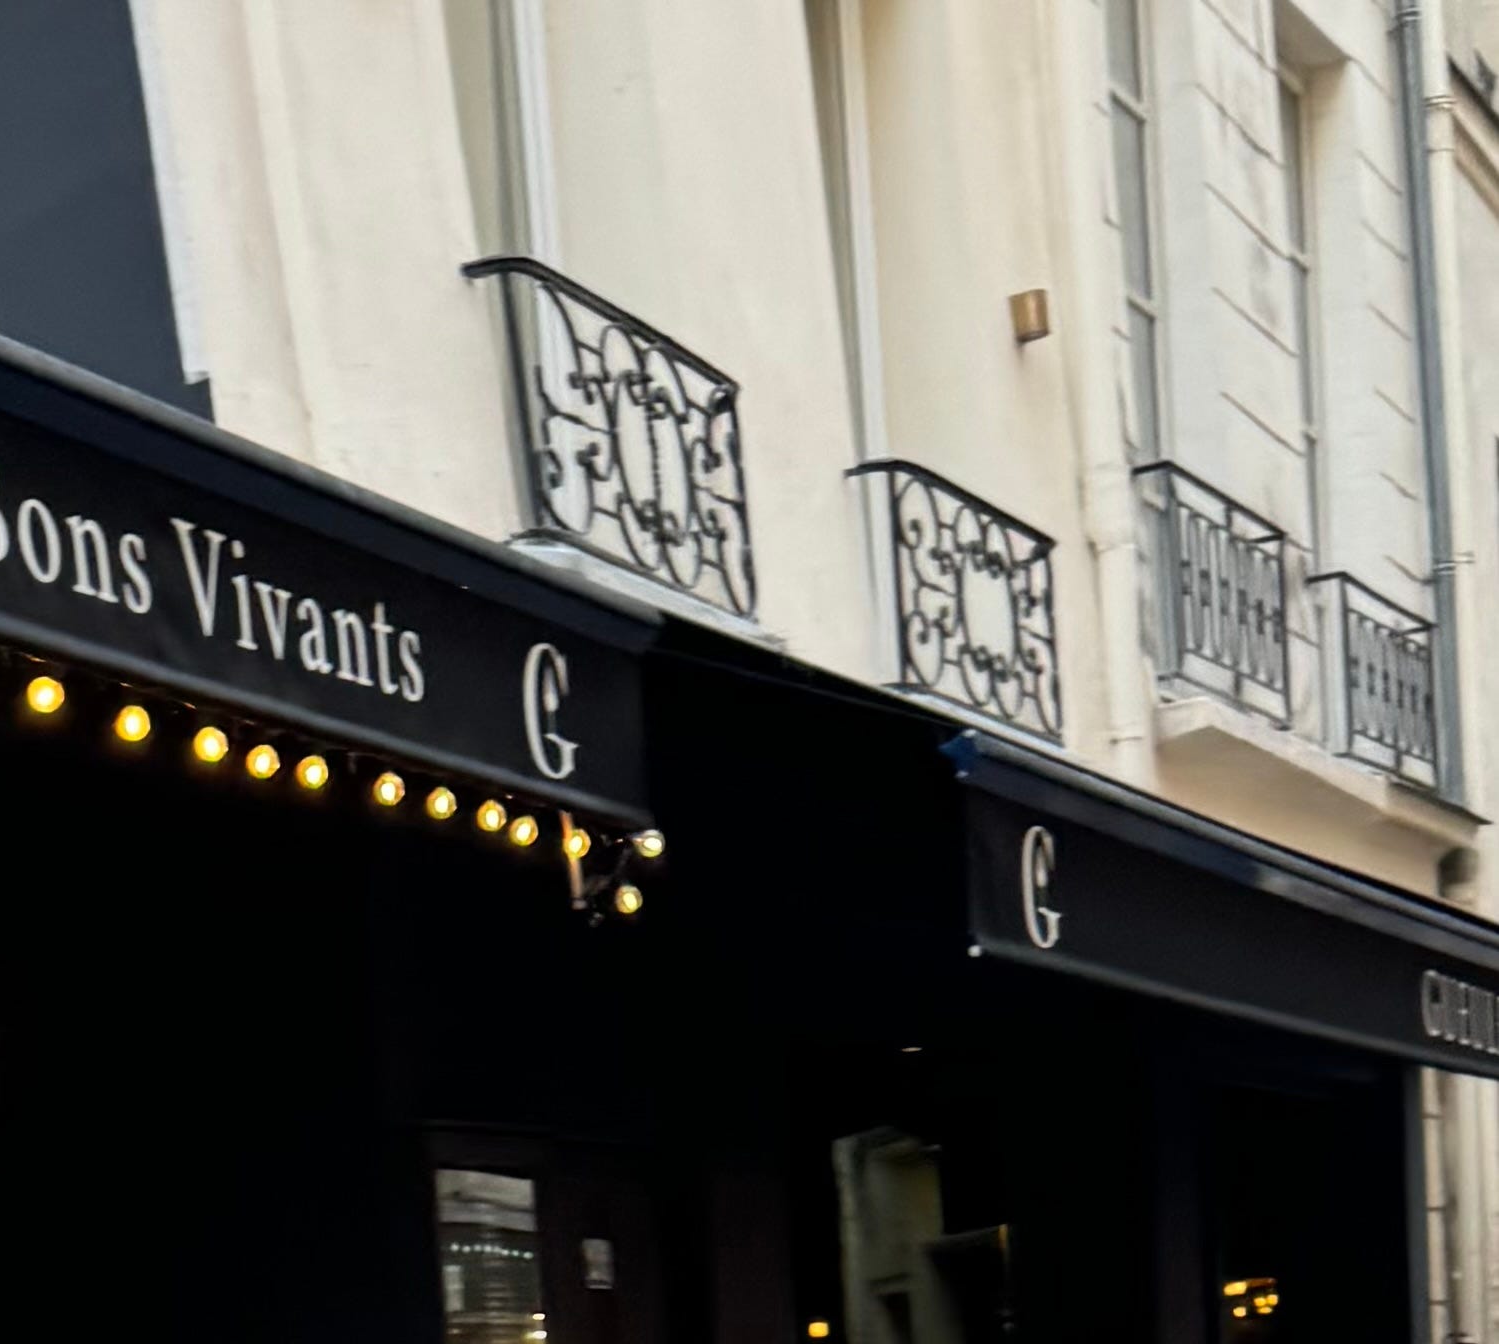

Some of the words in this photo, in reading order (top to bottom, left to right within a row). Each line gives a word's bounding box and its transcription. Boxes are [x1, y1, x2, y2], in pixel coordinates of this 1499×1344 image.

[170, 517, 425, 703] Vivants
[521, 642, 580, 781] G
[1019, 824, 1063, 950] G
